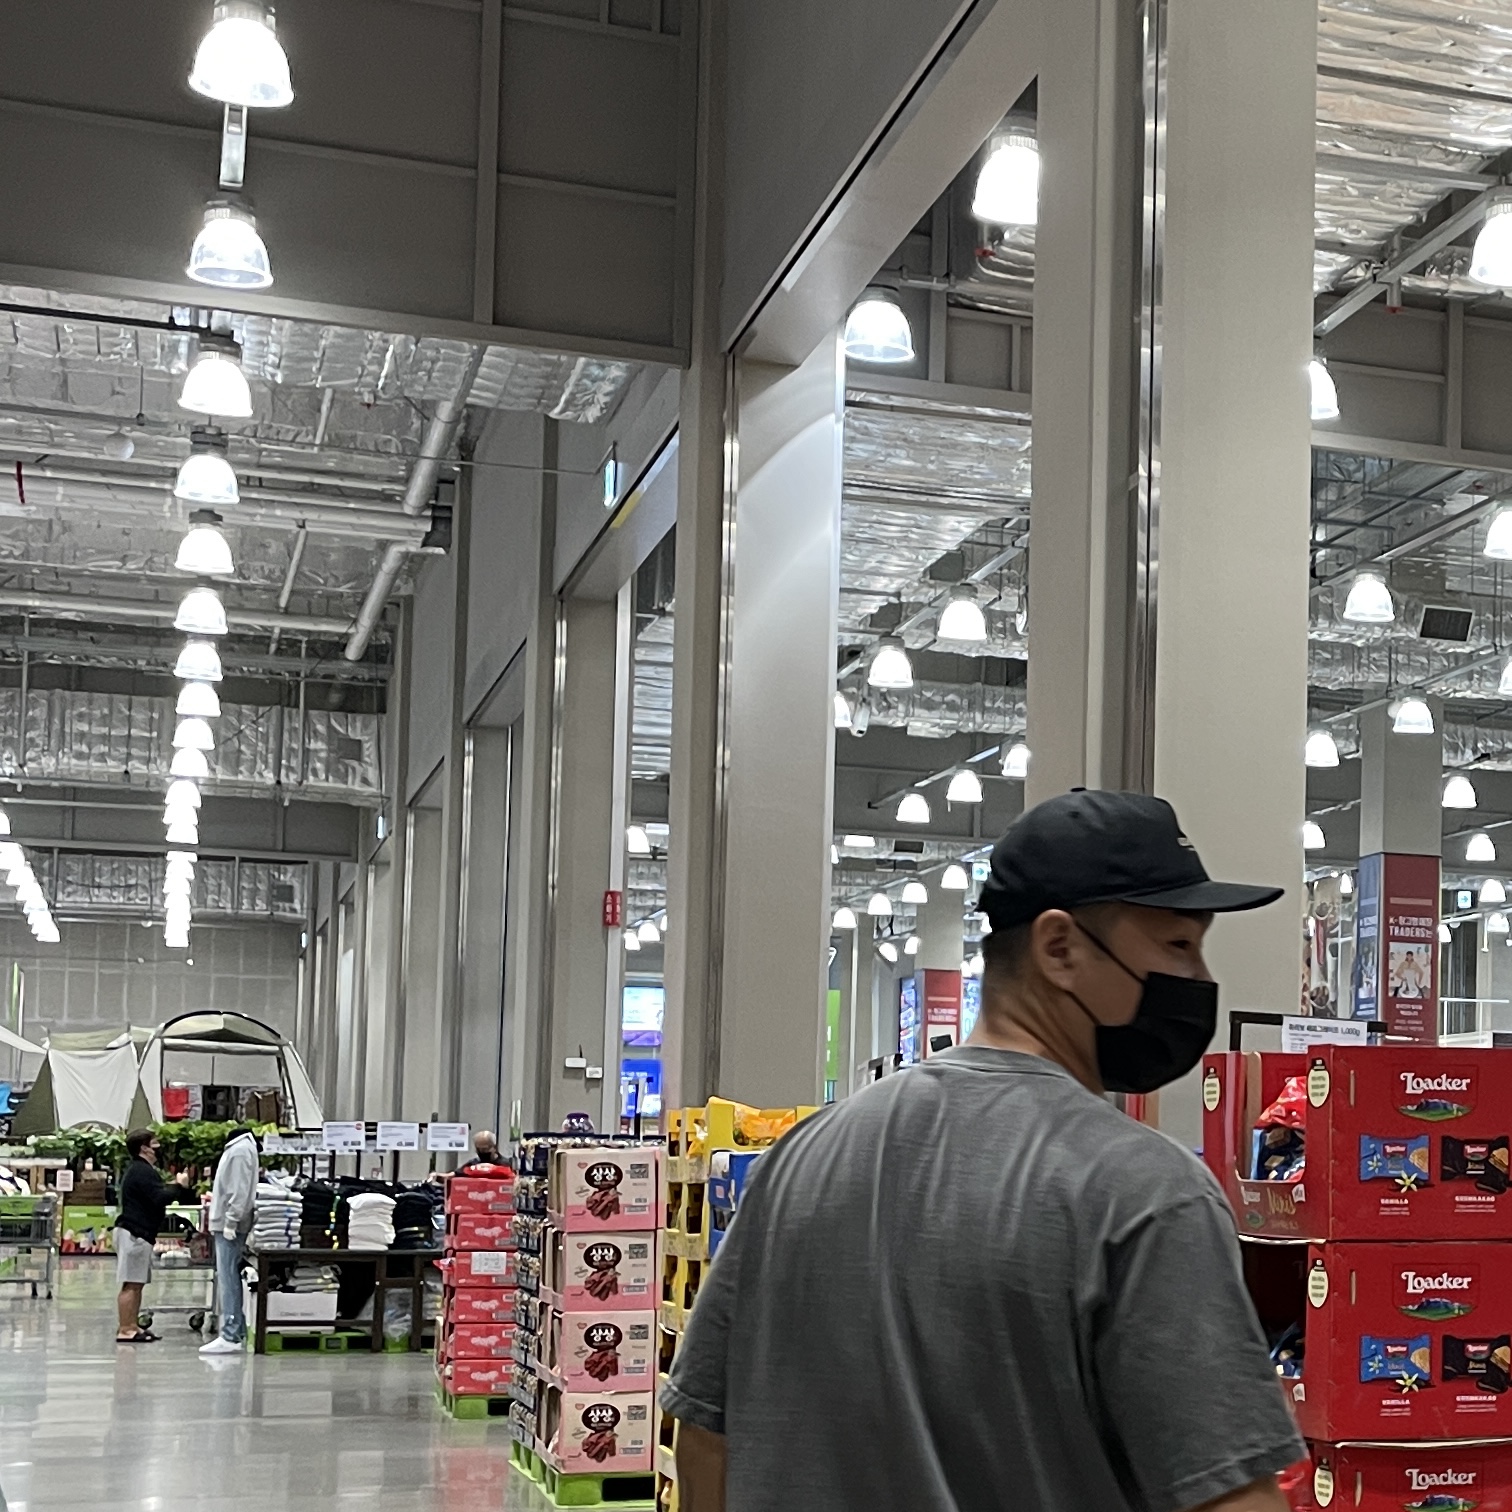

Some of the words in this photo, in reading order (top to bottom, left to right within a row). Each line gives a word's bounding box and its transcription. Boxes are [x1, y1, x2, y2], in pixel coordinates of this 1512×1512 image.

[1400, 1072, 1471, 1095] Loacker
[1402, 1269, 1472, 1294] Loacker
[1404, 1468, 1476, 1492] Loacker
